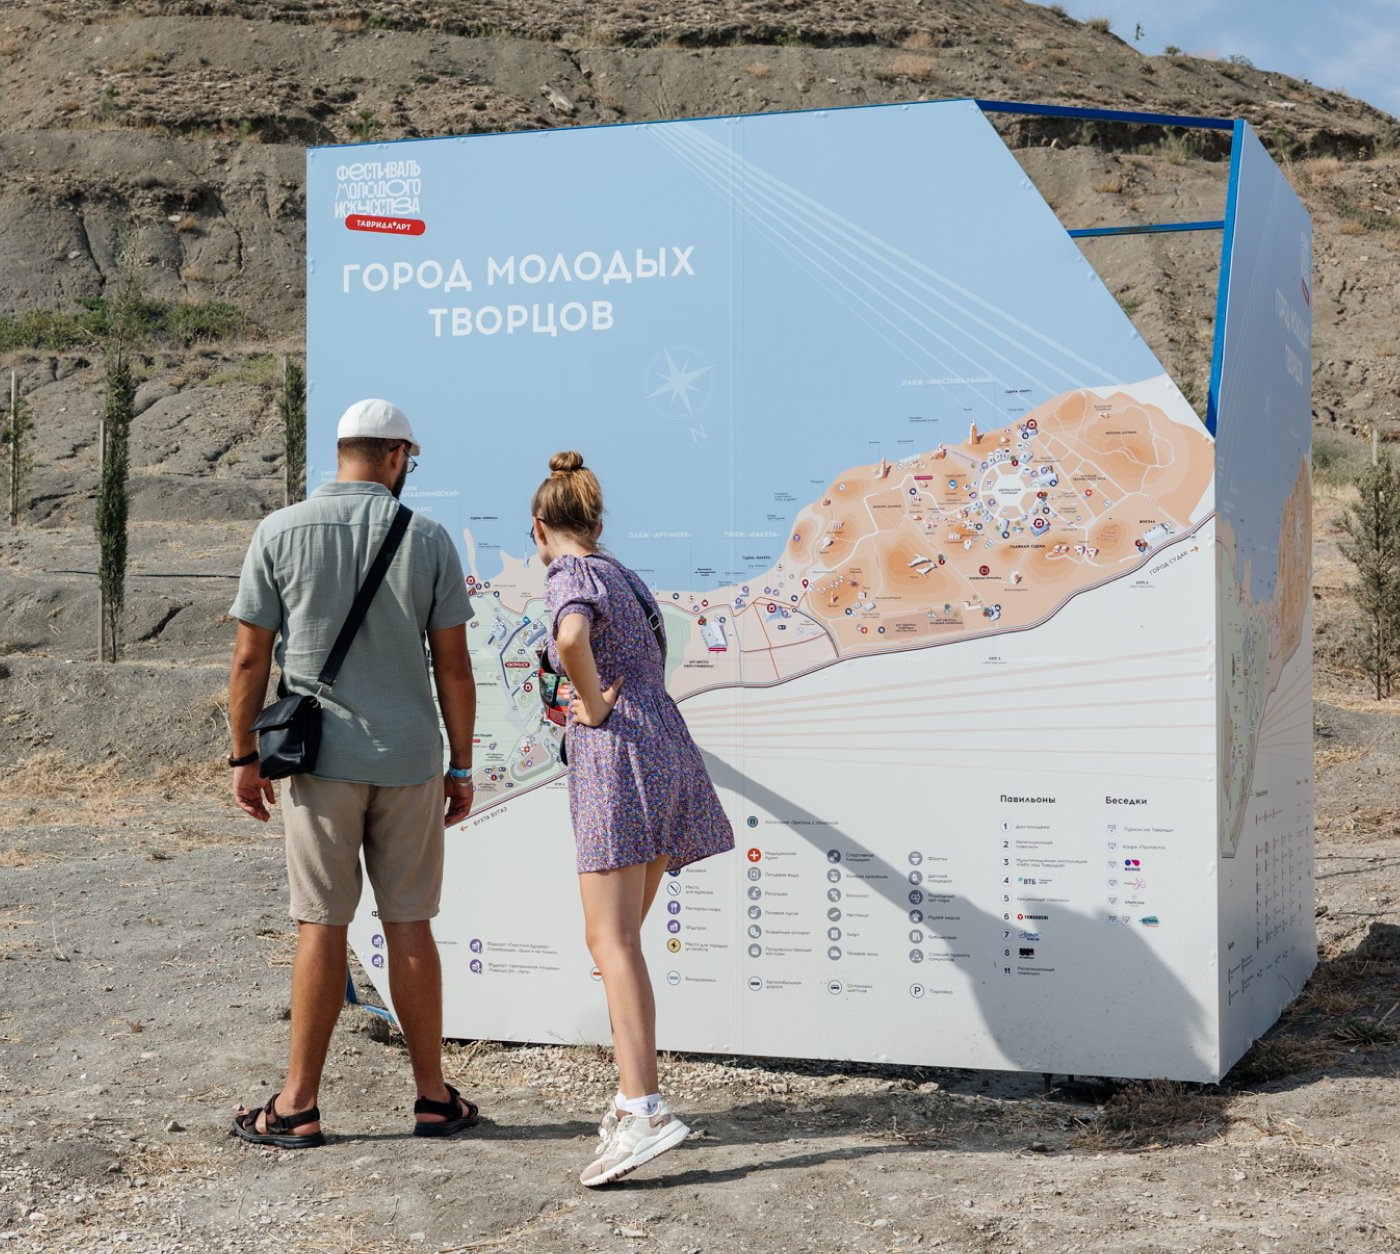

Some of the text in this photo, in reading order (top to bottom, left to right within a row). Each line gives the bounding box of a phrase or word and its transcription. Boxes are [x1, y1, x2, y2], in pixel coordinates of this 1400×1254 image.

[343, 245, 696, 293] ГОРОД МОЛОДЫХ
[428, 300, 614, 338] ТВОРЦОВ
[1149, 550, 1189, 576] ГОРОД СУДАК
[1000, 794, 1056, 804] Павильоны
[1105, 796, 1147, 806] Беседки
[473, 806, 508, 827] БУХТА БУГАЗ
[1003, 840, 1009, 848] 2
[1003, 858, 1009, 866] 3
[1003, 876, 1009, 884] 4
[1003, 894, 1010, 902] 5
[1003, 912, 1010, 920] 6
[1003, 931, 1010, 939] 7
[1004, 949, 1010, 957] 8
